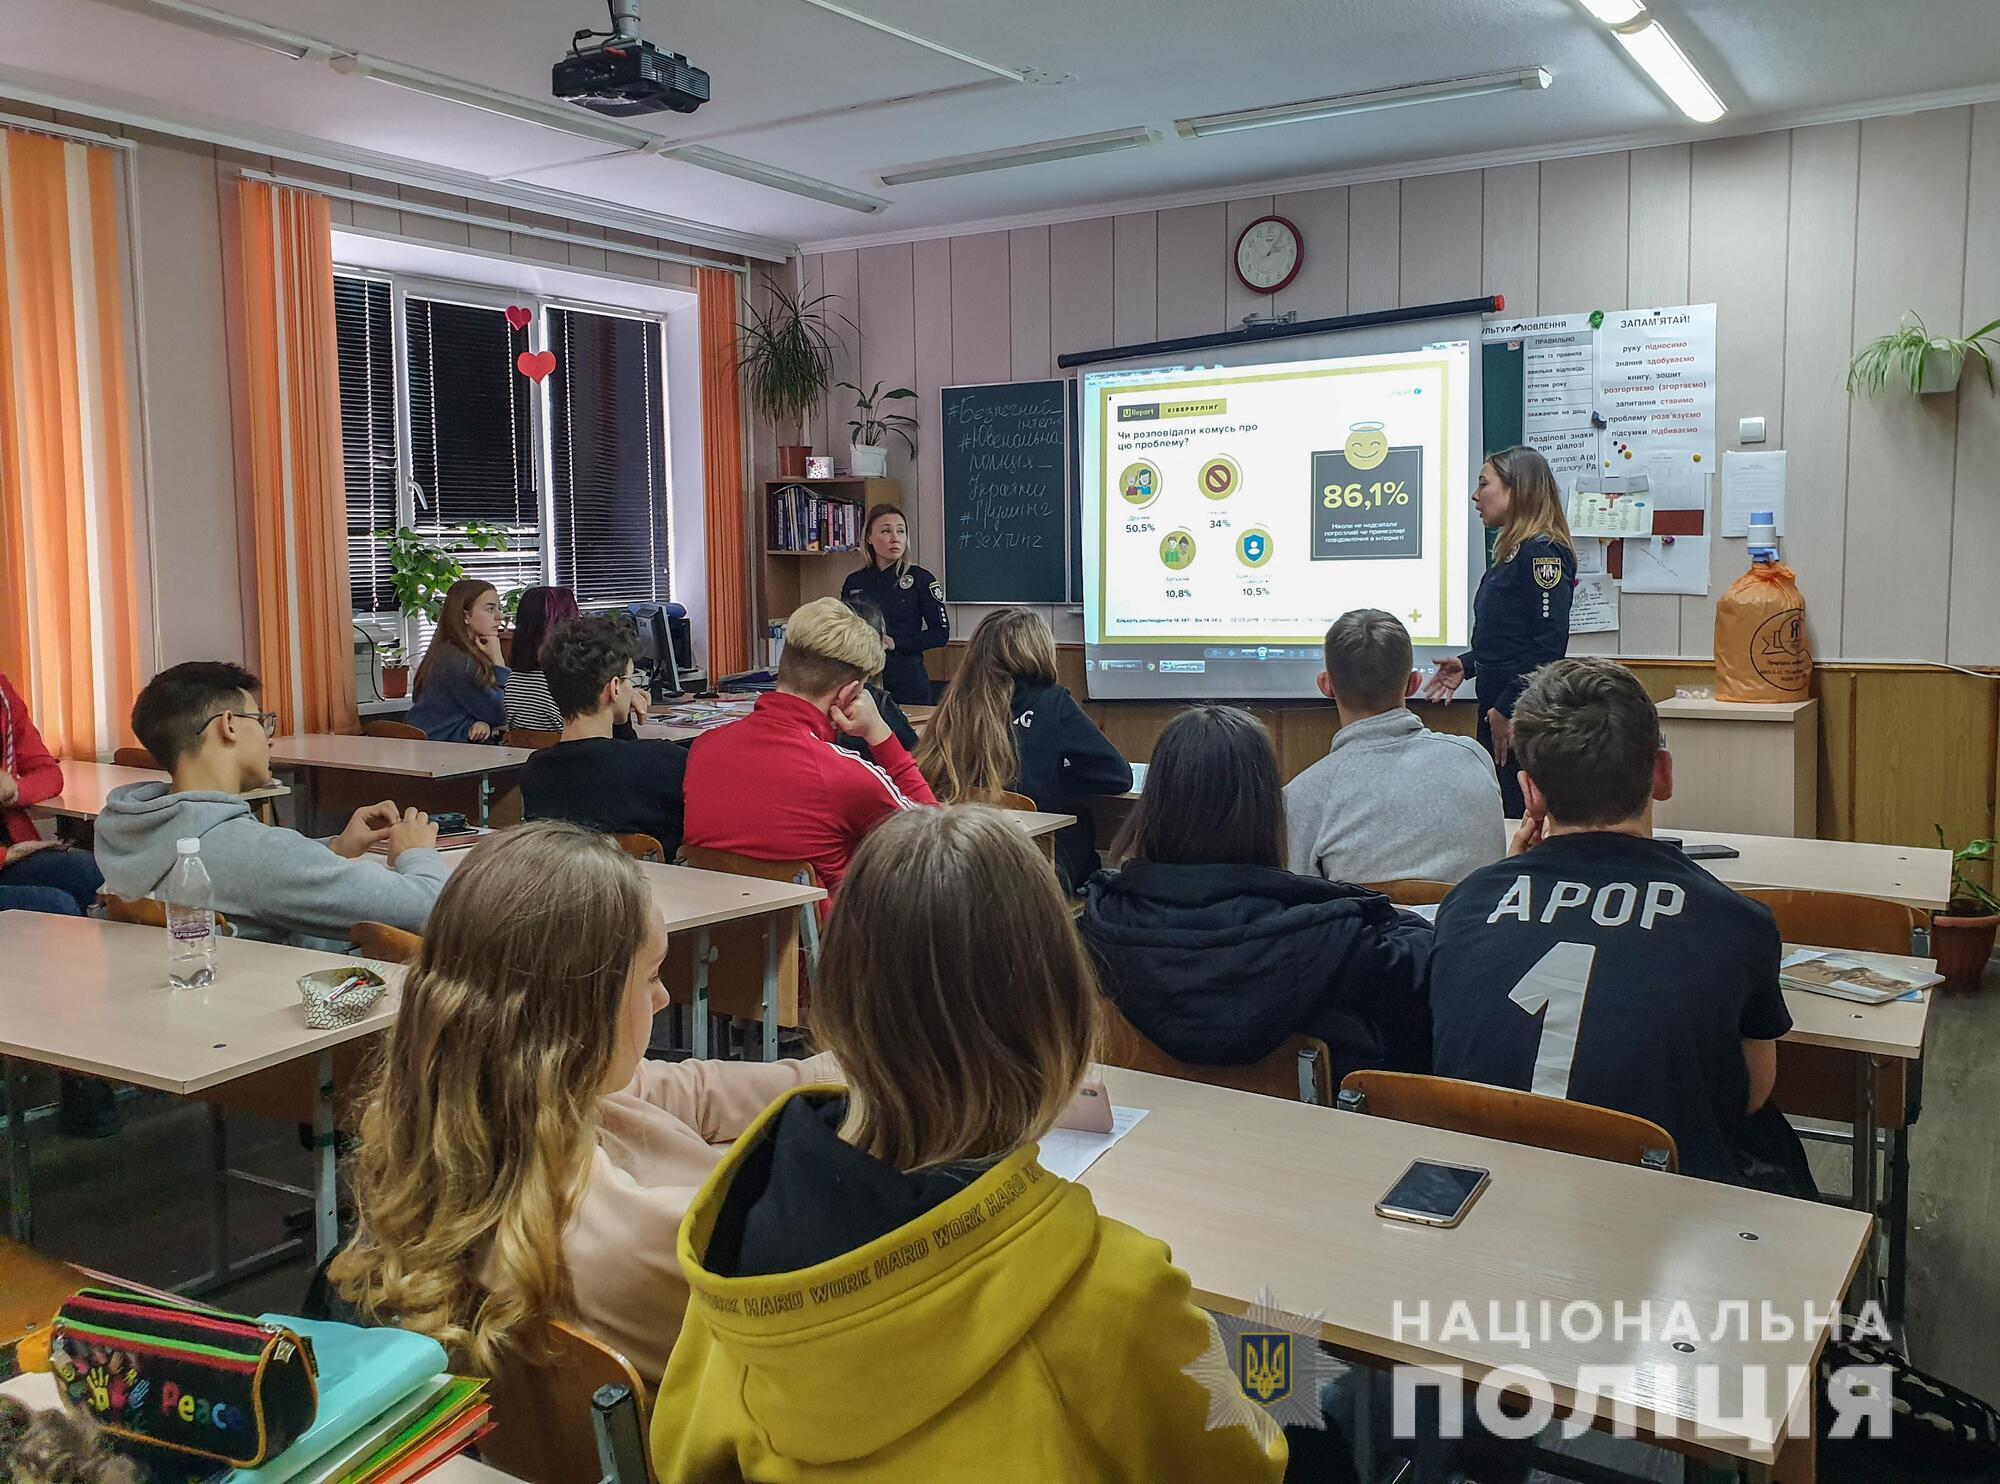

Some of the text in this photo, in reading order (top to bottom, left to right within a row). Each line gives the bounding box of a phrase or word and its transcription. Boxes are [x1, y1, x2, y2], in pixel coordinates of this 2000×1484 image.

[1521, 321, 1567, 332] МОВЛЕННЯ
[1620, 314, 1690, 329] ЗАПАМ'ЯТАЙ!
[1535, 336, 1576, 345] ПРАВИЛЬНО
[1645, 342, 1688, 350] підносимо
[1647, 356, 1695, 365] здобуваємо
[1604, 381, 1707, 395] розгортаємо (згортаємо)
[1615, 400, 1657, 408] запитання
[1608, 415, 1647, 423] проблему
[1118, 423, 1258, 440] Чи розповідали комусь про
[1611, 427, 1698, 437] підсумки підбиваємо
[1528, 433, 1566, 443] Розділові
[1118, 438, 1190, 451] цю проблему?
[1556, 442, 1585, 451] діалозі
[1323, 481, 1409, 510] 86,1%
[1209, 520, 1231, 529] 34%
[1508, 941, 1596, 1100] 1
[743, 1290, 804, 1317] HARD
[809, 1267, 872, 1304] WORK
[873, 1237, 929, 1280] HARD
[933, 1203, 987, 1249] WORK
[984, 1173, 1027, 1217] HARD
